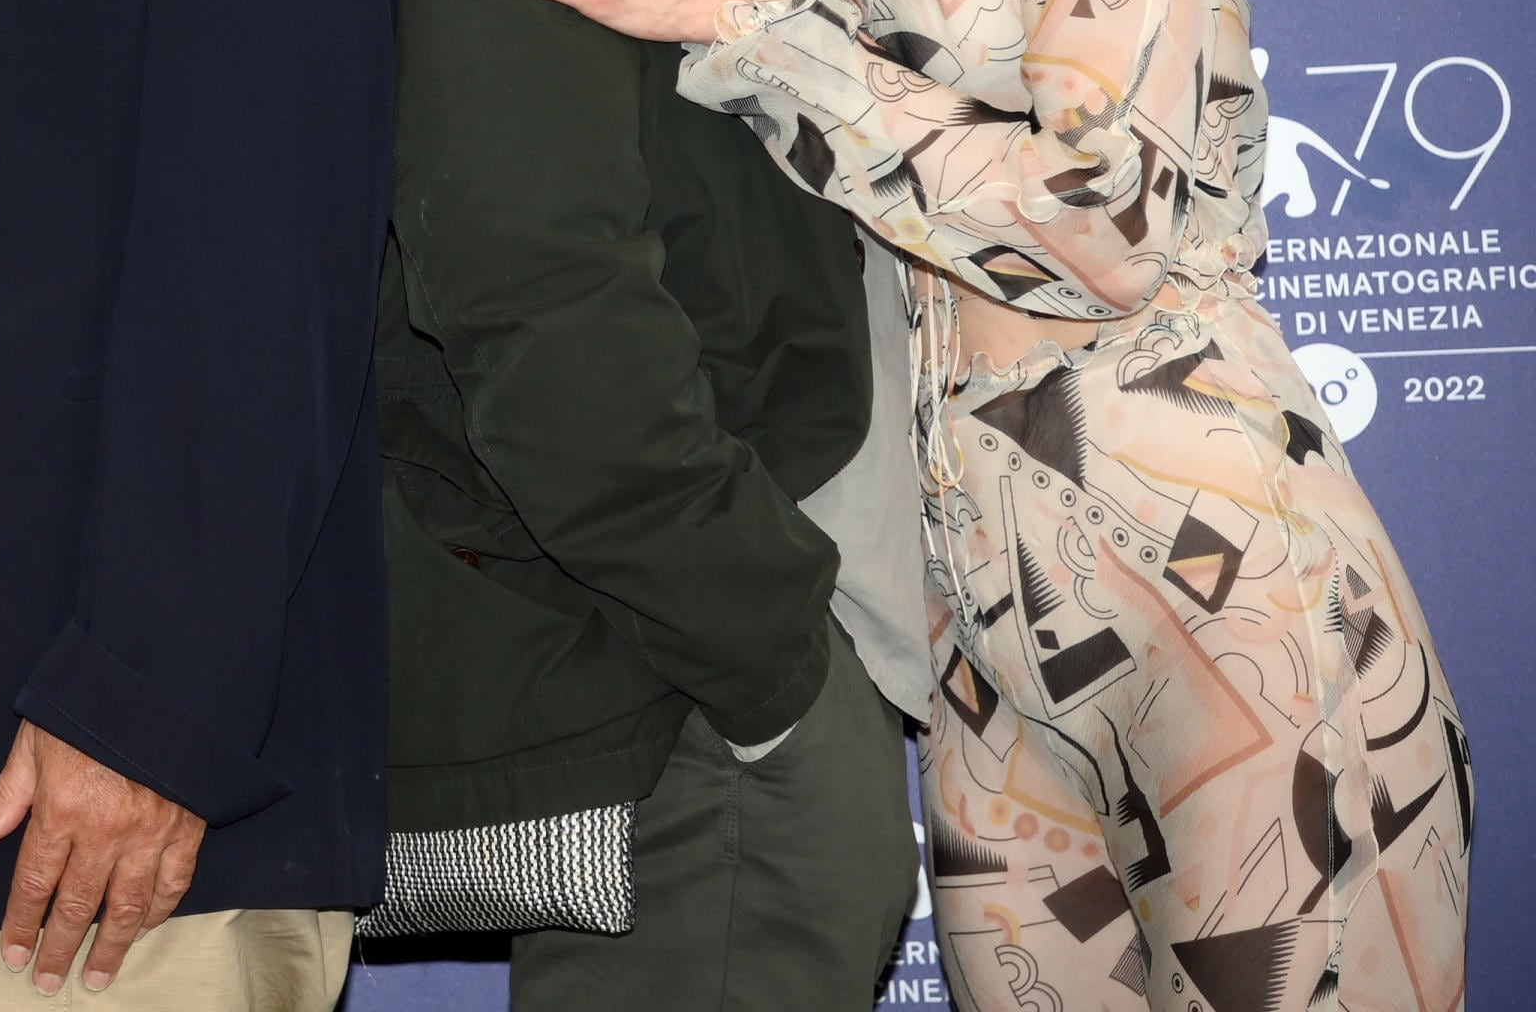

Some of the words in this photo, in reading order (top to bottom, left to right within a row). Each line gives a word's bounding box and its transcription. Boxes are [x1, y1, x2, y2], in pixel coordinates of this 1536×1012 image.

[1305, 55, 1511, 217] 79
[1295, 310, 1327, 336] DI
[1337, 304, 1483, 334] VENEZIA
[1404, 375, 1486, 403] 2022
